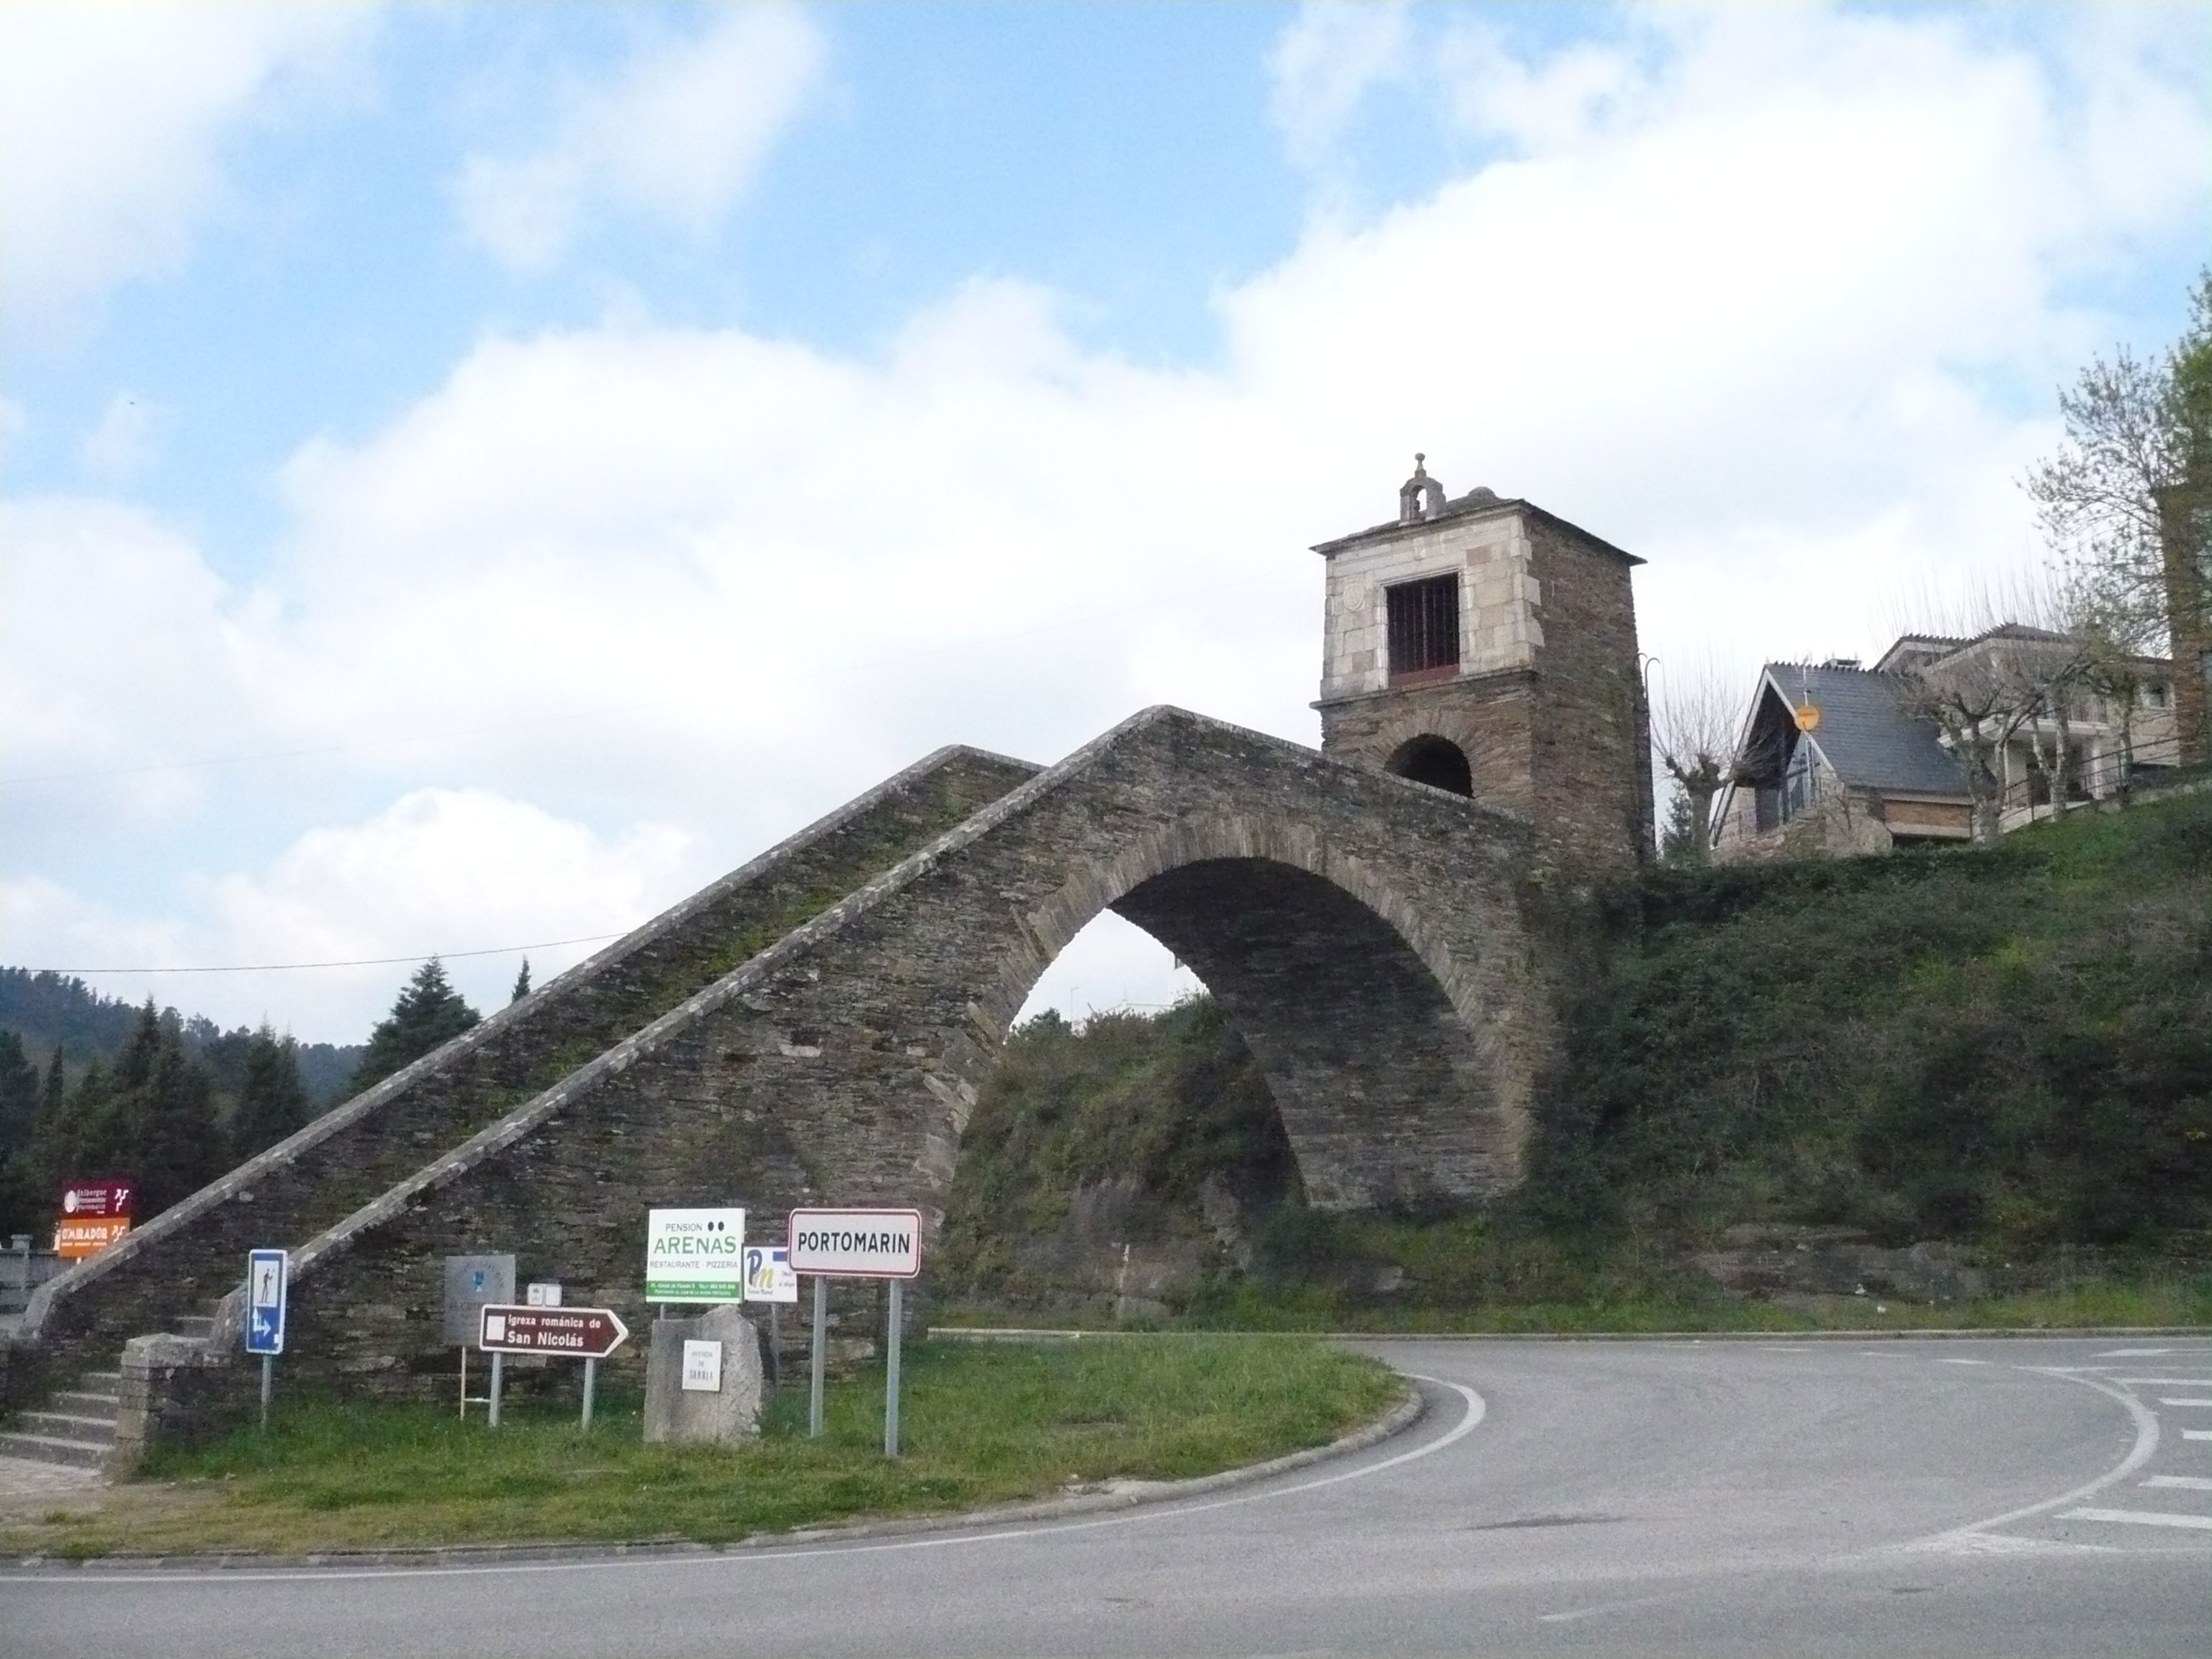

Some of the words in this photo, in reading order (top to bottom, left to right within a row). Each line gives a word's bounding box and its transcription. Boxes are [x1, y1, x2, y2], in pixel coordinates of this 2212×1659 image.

[665, 1223, 703, 1232] PENSION
[653, 1236, 737, 1254] ARENAS
[798, 1232, 910, 1254] PORTOMARIN
[508, 1314, 536, 1326] Igrexa
[541, 1316, 584, 1328] románica
[589, 1319, 601, 1328] de
[508, 1331, 531, 1344] San
[537, 1332, 584, 1347] Nicolás
